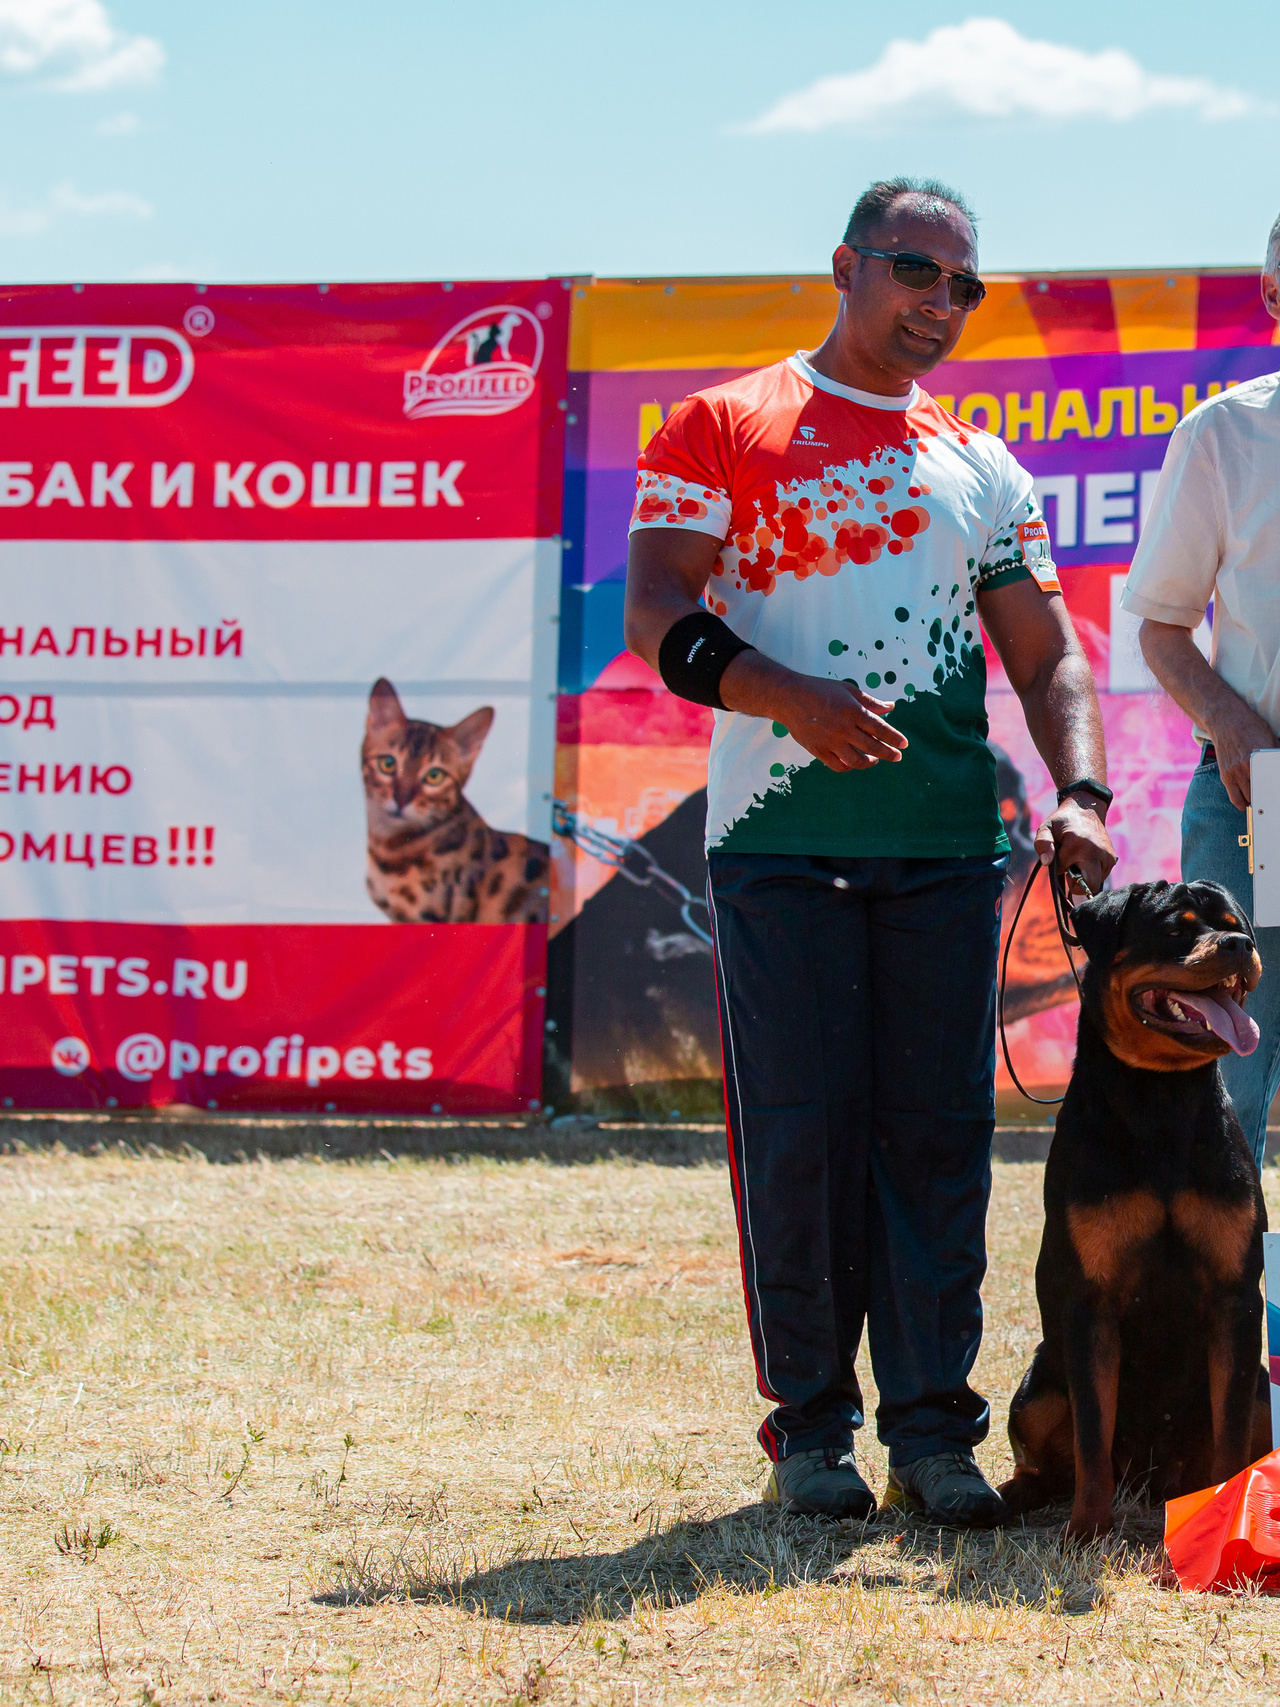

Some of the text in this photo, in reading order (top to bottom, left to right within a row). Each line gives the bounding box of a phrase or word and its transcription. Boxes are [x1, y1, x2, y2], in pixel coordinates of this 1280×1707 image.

[791, 439, 830, 448] TRIUMPH
[150, 461, 194, 508] И
[213, 460, 466, 508] КОШЕК
[0, 618, 243, 657] НАЛЬНЫЙ
[116, 1032, 433, 1087] @profipets
